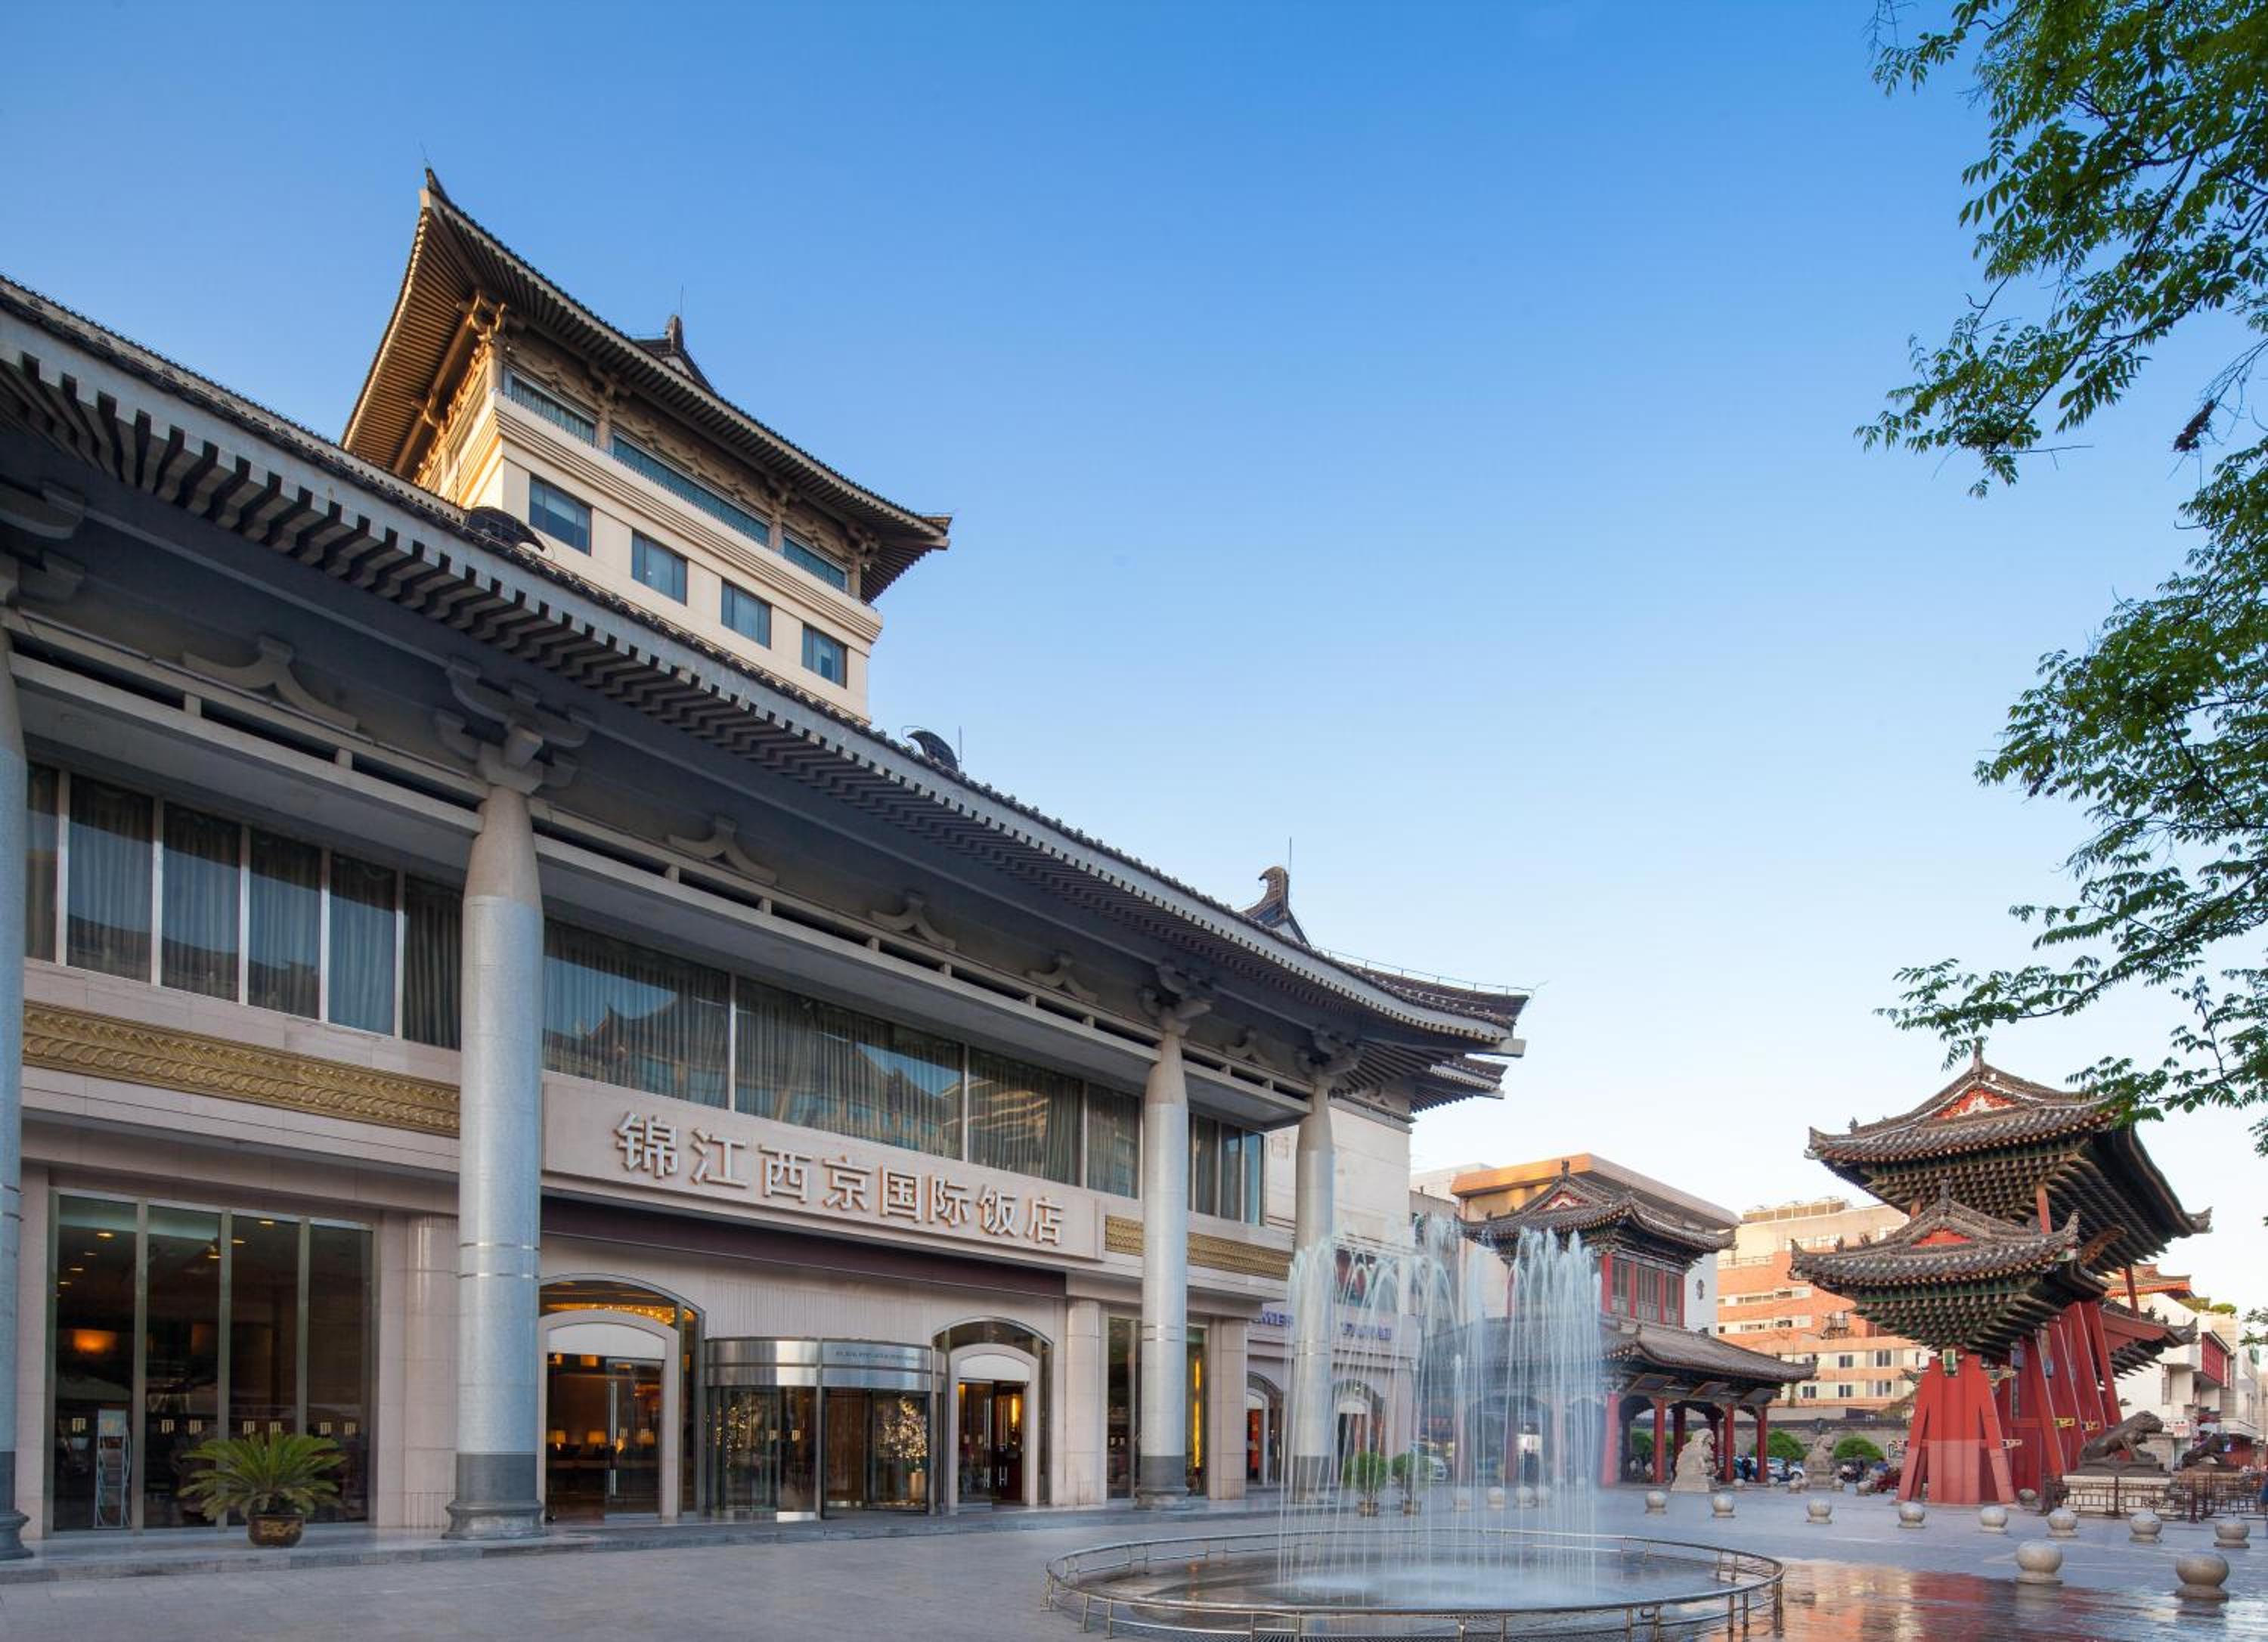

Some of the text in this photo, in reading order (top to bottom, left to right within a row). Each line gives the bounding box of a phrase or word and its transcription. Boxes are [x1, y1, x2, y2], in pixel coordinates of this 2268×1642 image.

[615, 1112, 1064, 1245] 锦江西京国际饭店
